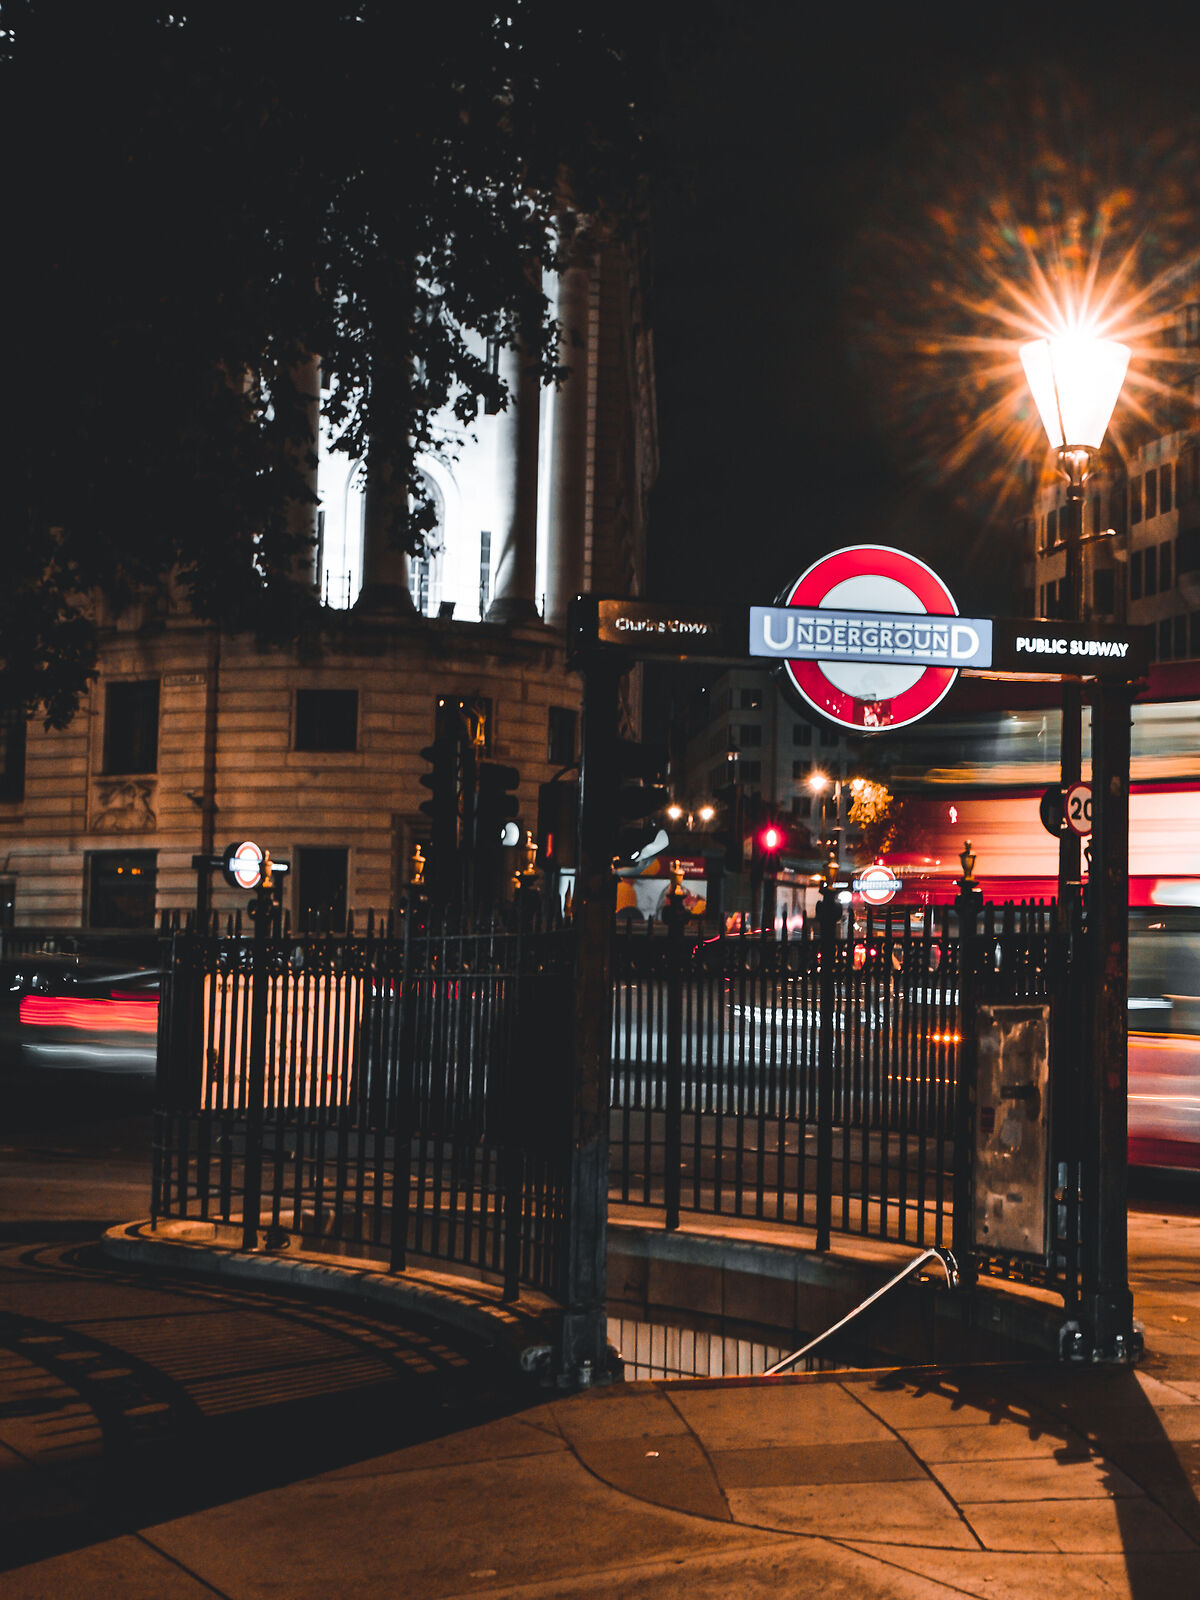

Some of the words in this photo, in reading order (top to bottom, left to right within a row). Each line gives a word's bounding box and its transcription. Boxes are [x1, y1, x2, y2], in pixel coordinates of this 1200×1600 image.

[763, 614, 980, 660] UNDERGROUND
[1016, 637, 1068, 655] PUBLIC
[1069, 640, 1129, 658] SUBWAY
